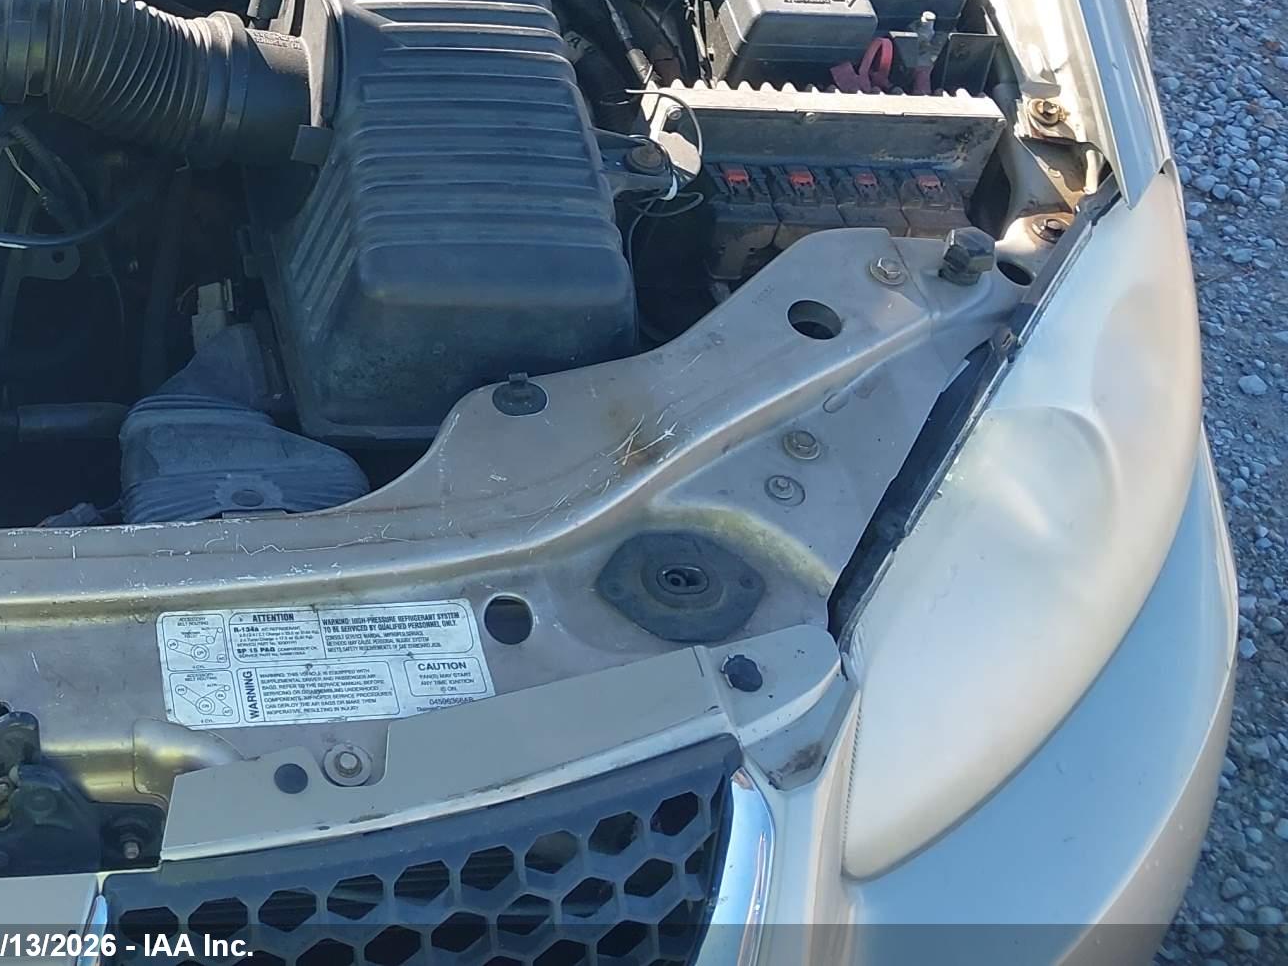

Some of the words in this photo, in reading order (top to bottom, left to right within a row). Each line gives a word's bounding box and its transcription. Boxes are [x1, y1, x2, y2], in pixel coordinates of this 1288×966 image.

[252, 614, 294, 622] ATTENTION
[351, 616, 395, 624] HIGH-PRESSURE
[397, 613, 435, 621] REFRIGERANT
[408, 621, 440, 629] PERSONNEL
[418, 662, 466, 671] CAUTION
[243, 671, 259, 719] WARNING
